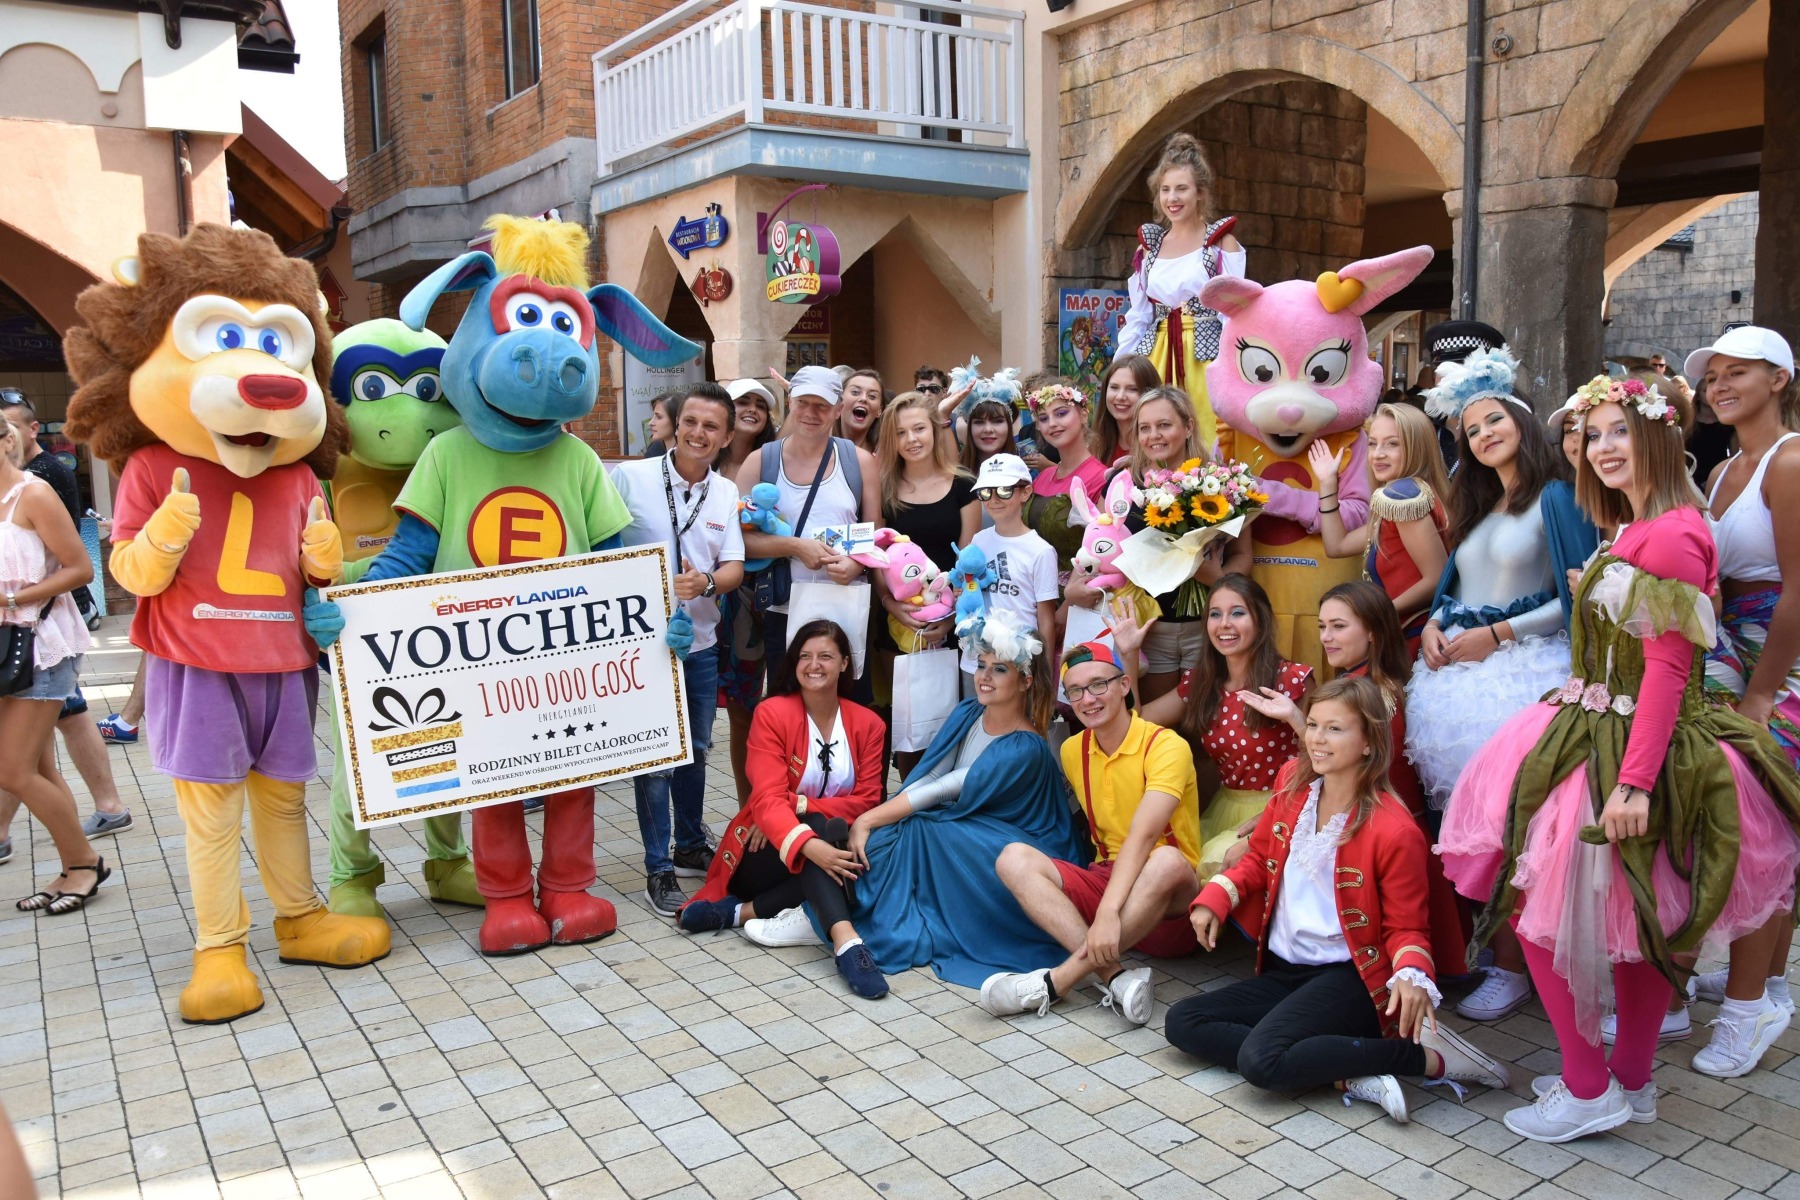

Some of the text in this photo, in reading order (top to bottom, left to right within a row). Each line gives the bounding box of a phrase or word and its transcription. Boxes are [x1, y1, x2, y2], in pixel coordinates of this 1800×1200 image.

[768, 277, 819, 298] CUKIERECZEK
[1066, 295, 1100, 311] MAP
[1104, 296, 1124, 311] OF
[217, 491, 287, 597] L
[498, 506, 545, 565] E
[436, 585, 588, 616] ENERGYLANDIA
[982, 578, 1020, 596] das
[197, 610, 295, 620] ENERGYLANDIA
[360, 594, 655, 675] VOUCHER
[545, 667, 587, 706] 000
[591, 647, 645, 698] GOŚĆ
[538, 703, 597, 723] ENERGYLANDII
[101, 727, 116, 737] N
[468, 726, 669, 775] RODZINNY BILET CAŁOROCZNY
[471, 776, 491, 786] ORAZ
[490, 771, 525, 783] WEEKEND
[532, 762, 563, 775] OŚRODKU
[563, 751, 623, 768] WYPOCZYNKOWYM
[622, 745, 652, 757] WESTERN
[651, 741, 670, 751] CAMP
